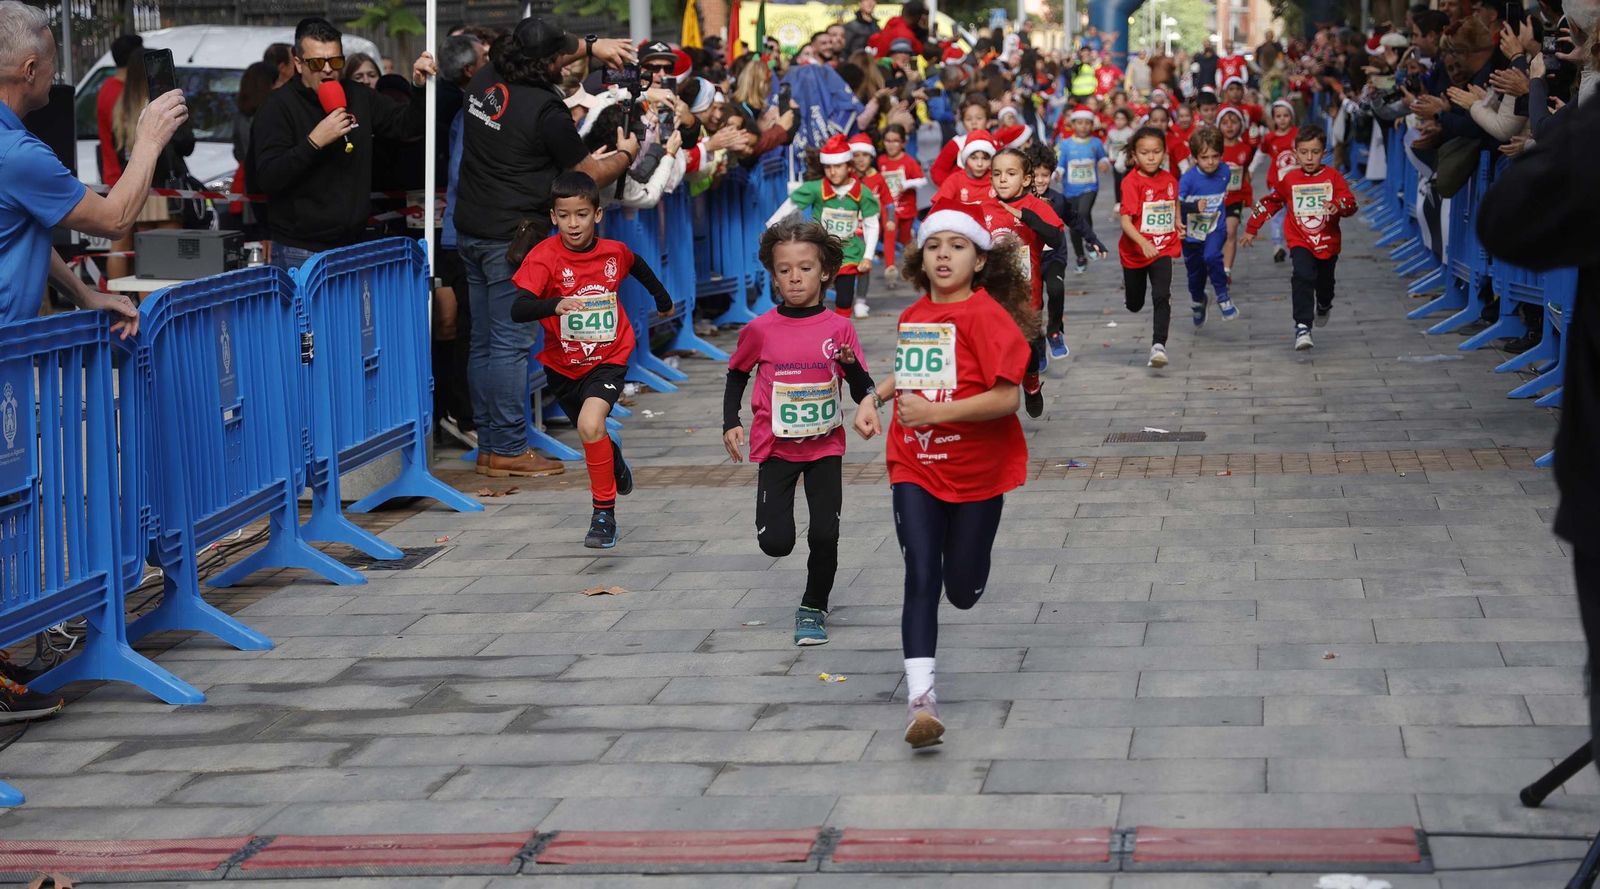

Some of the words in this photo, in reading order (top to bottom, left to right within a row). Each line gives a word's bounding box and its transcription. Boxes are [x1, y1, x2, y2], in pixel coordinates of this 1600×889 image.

[1296, 195, 1328, 208] 735
[827, 219, 853, 232] 665
[1146, 213, 1173, 226] 683
[567, 310, 615, 331] 640
[780, 399, 837, 424] 630
